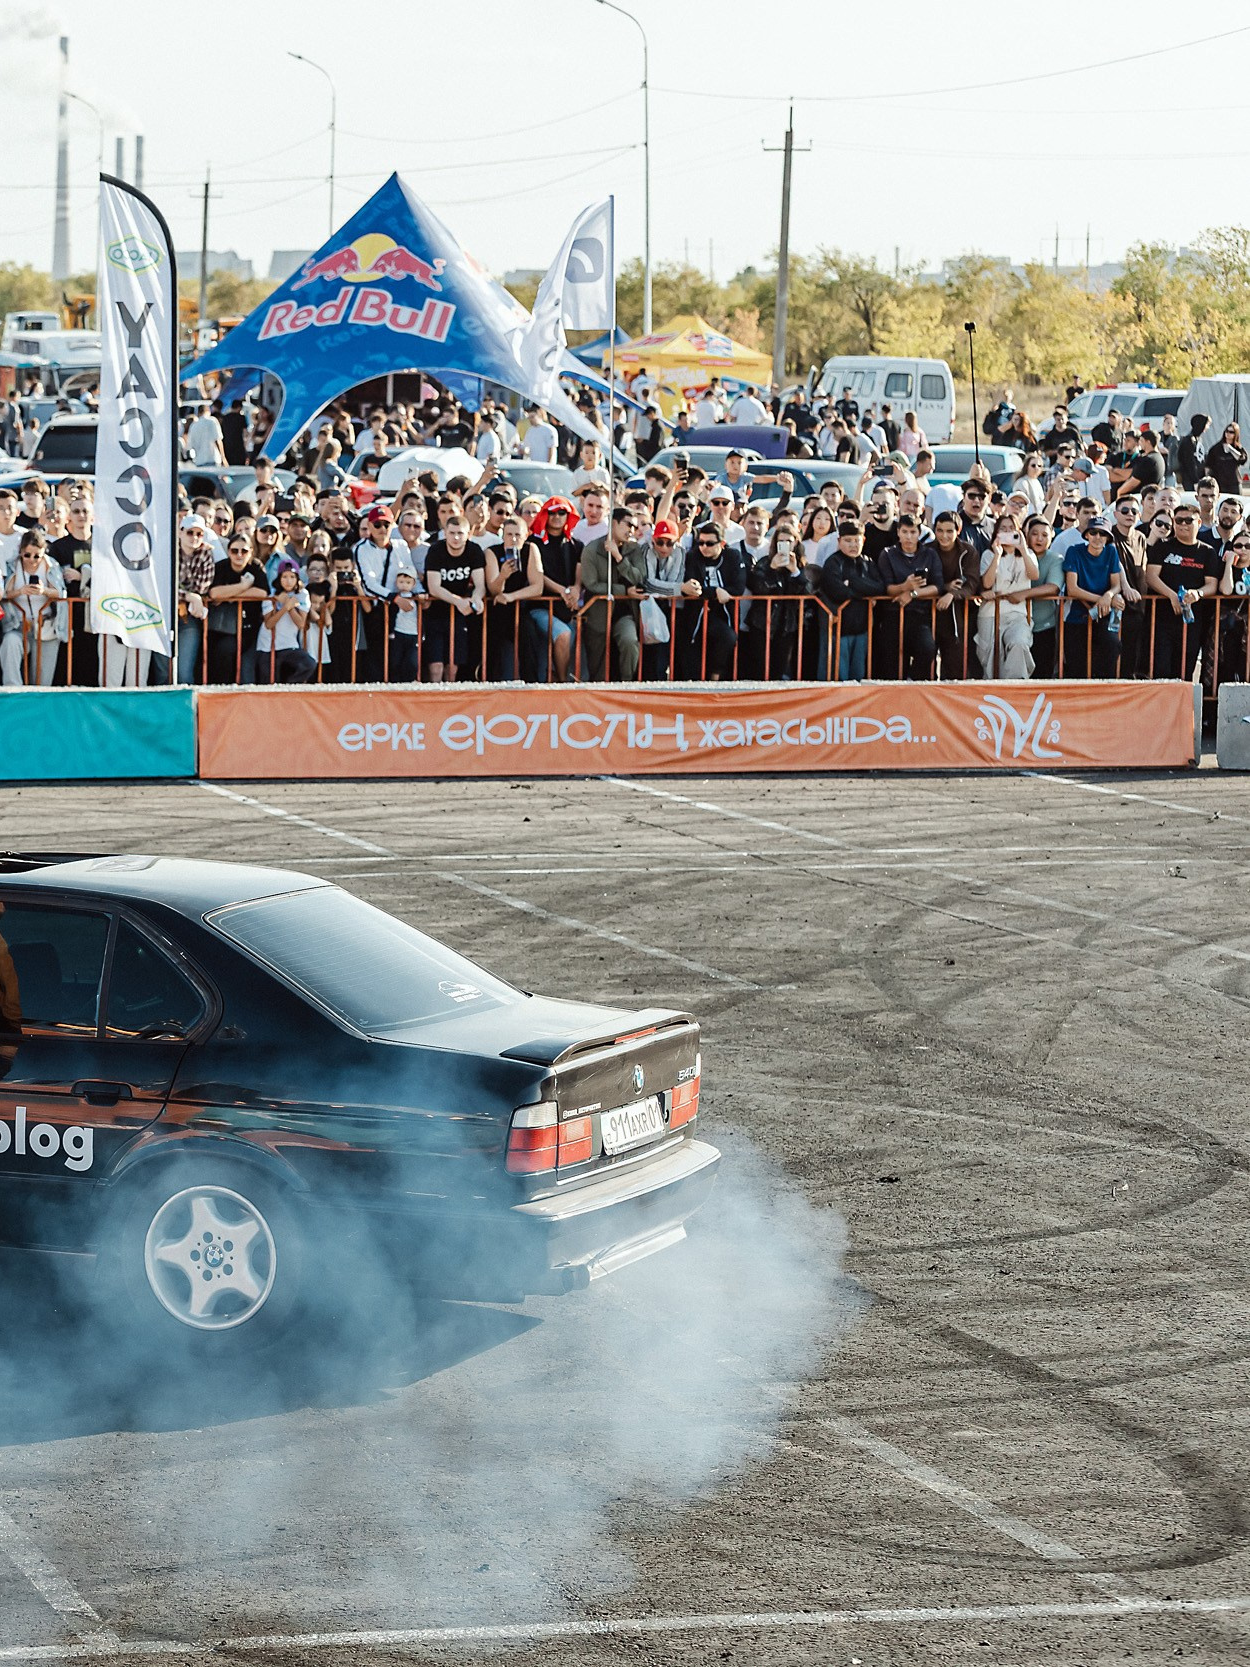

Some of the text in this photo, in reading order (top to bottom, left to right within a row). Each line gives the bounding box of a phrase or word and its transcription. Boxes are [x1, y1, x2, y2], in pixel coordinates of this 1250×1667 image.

[258, 287, 456, 343] Red Bull
[440, 566, 471, 582] BOSS
